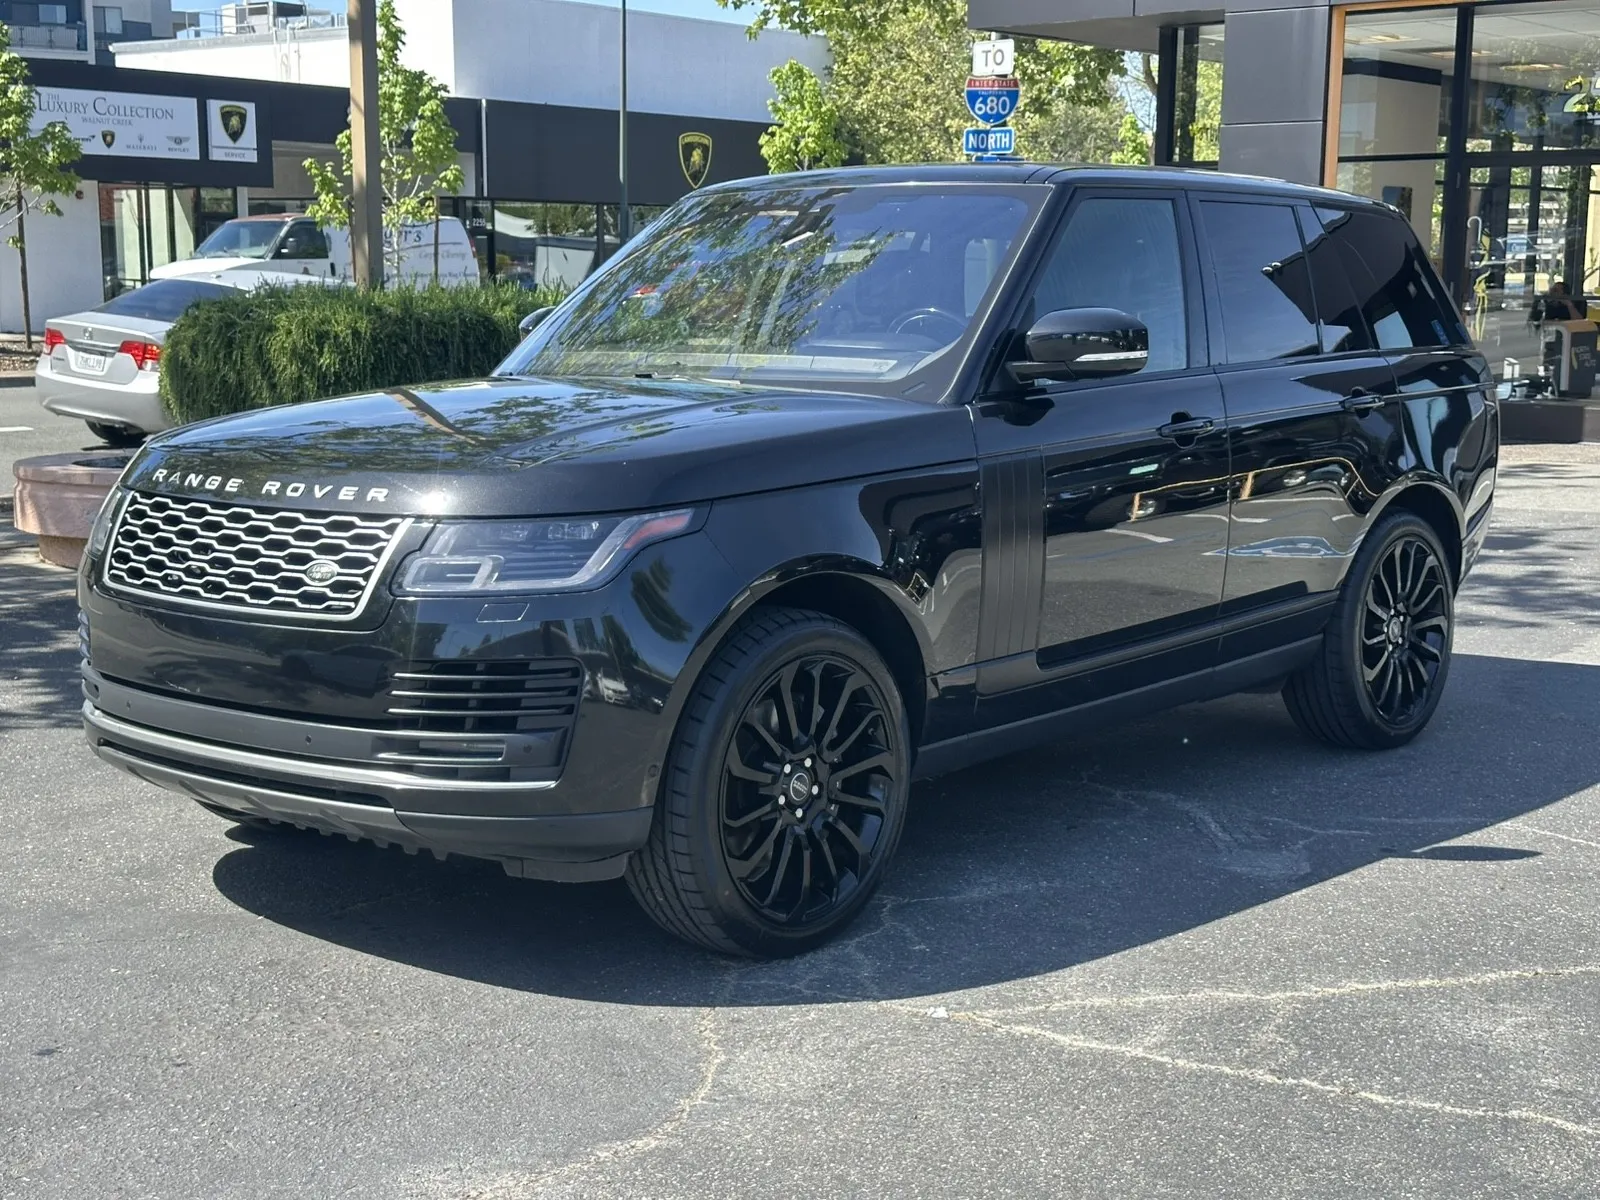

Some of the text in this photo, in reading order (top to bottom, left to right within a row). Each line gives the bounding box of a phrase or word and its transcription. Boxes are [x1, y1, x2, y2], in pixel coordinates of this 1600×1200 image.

[981, 49, 1005, 67] TO
[971, 79, 1015, 88] INTERSTATE
[38, 91, 174, 120] LUXURY COLLECTION
[974, 96, 1010, 115] 680
[81, 115, 134, 127] WALNUT CREEK
[968, 132, 1010, 150] NORTH
[224, 151, 246, 159] SERVICE
[152, 468, 390, 502] RANGE ROVER
